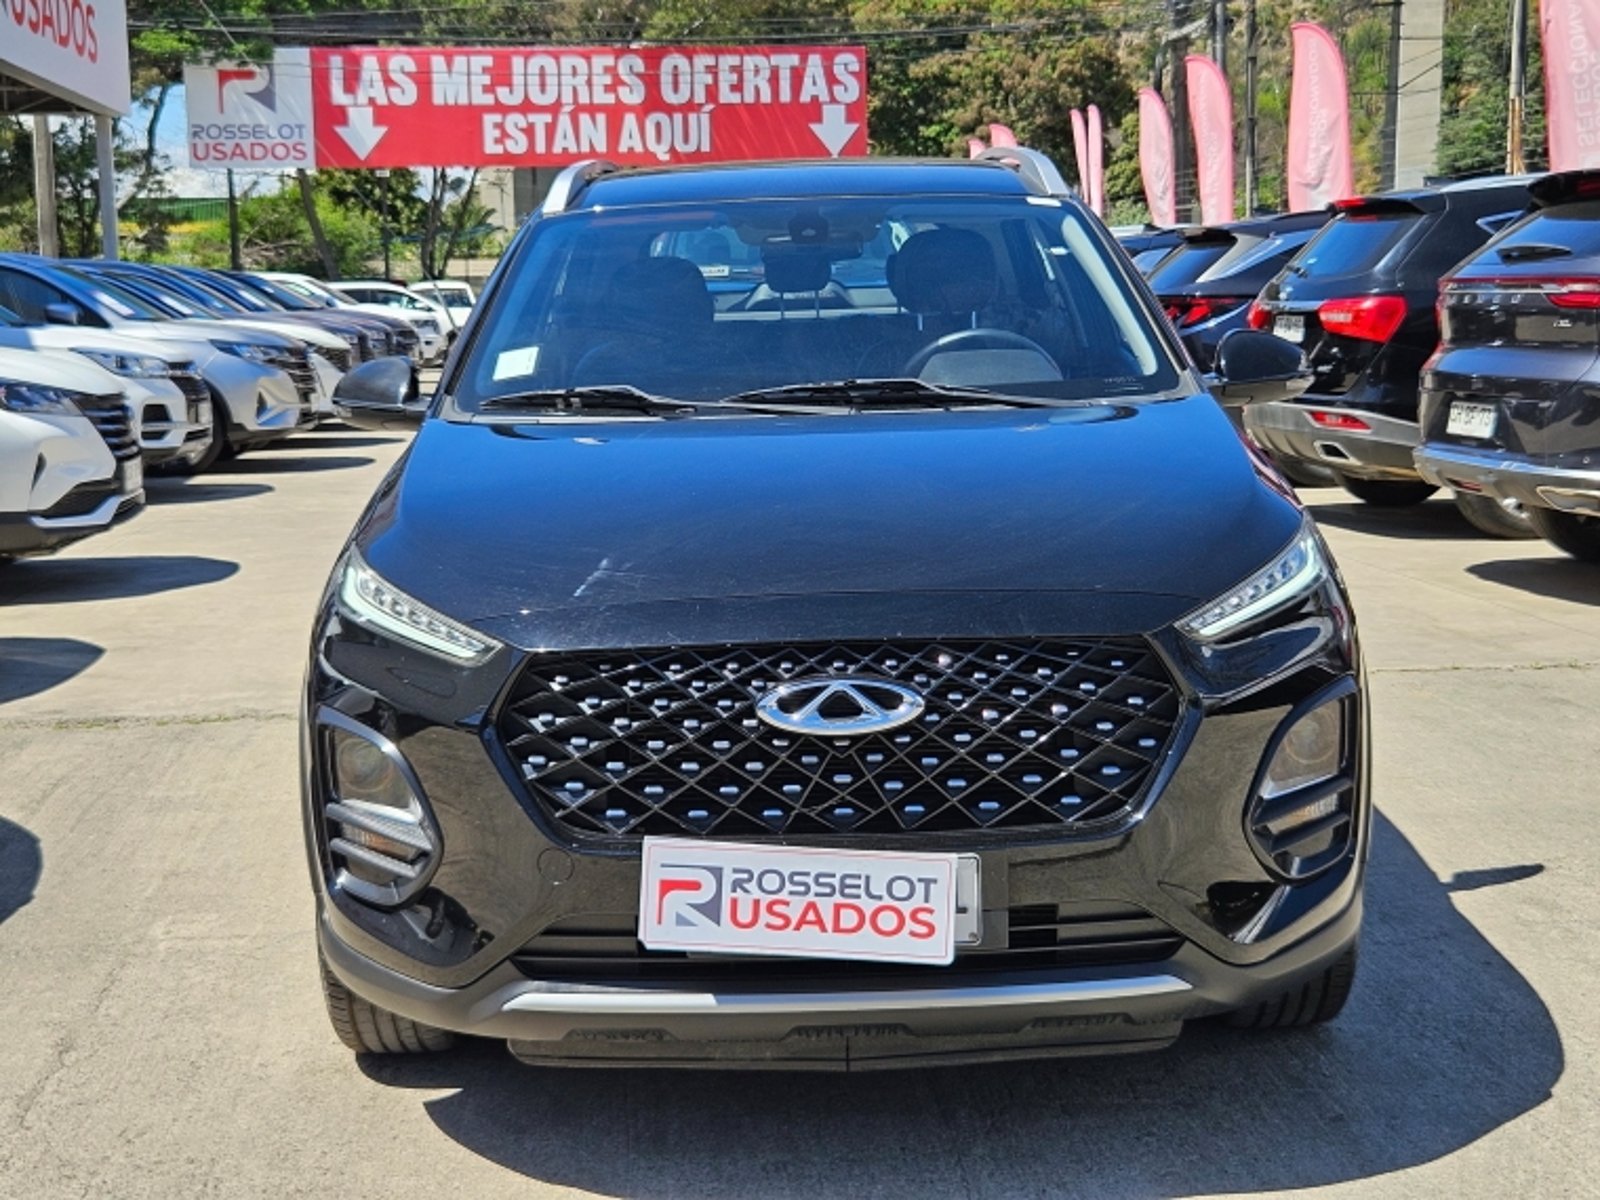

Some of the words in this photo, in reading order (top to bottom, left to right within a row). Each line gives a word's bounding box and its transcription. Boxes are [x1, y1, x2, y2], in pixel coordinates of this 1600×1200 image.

[329, 54, 418, 107] LAS
[431, 53, 647, 107] MEJORES
[659, 52, 861, 106] OFERTAS
[191, 123, 306, 140] ROSSELOT
[482, 103, 608, 155] ESTÁN
[617, 104, 712, 162] AQUÍ
[192, 142, 308, 161] USADOS
[730, 867, 938, 903] ROSSELOT
[729, 897, 936, 940] USADOS
